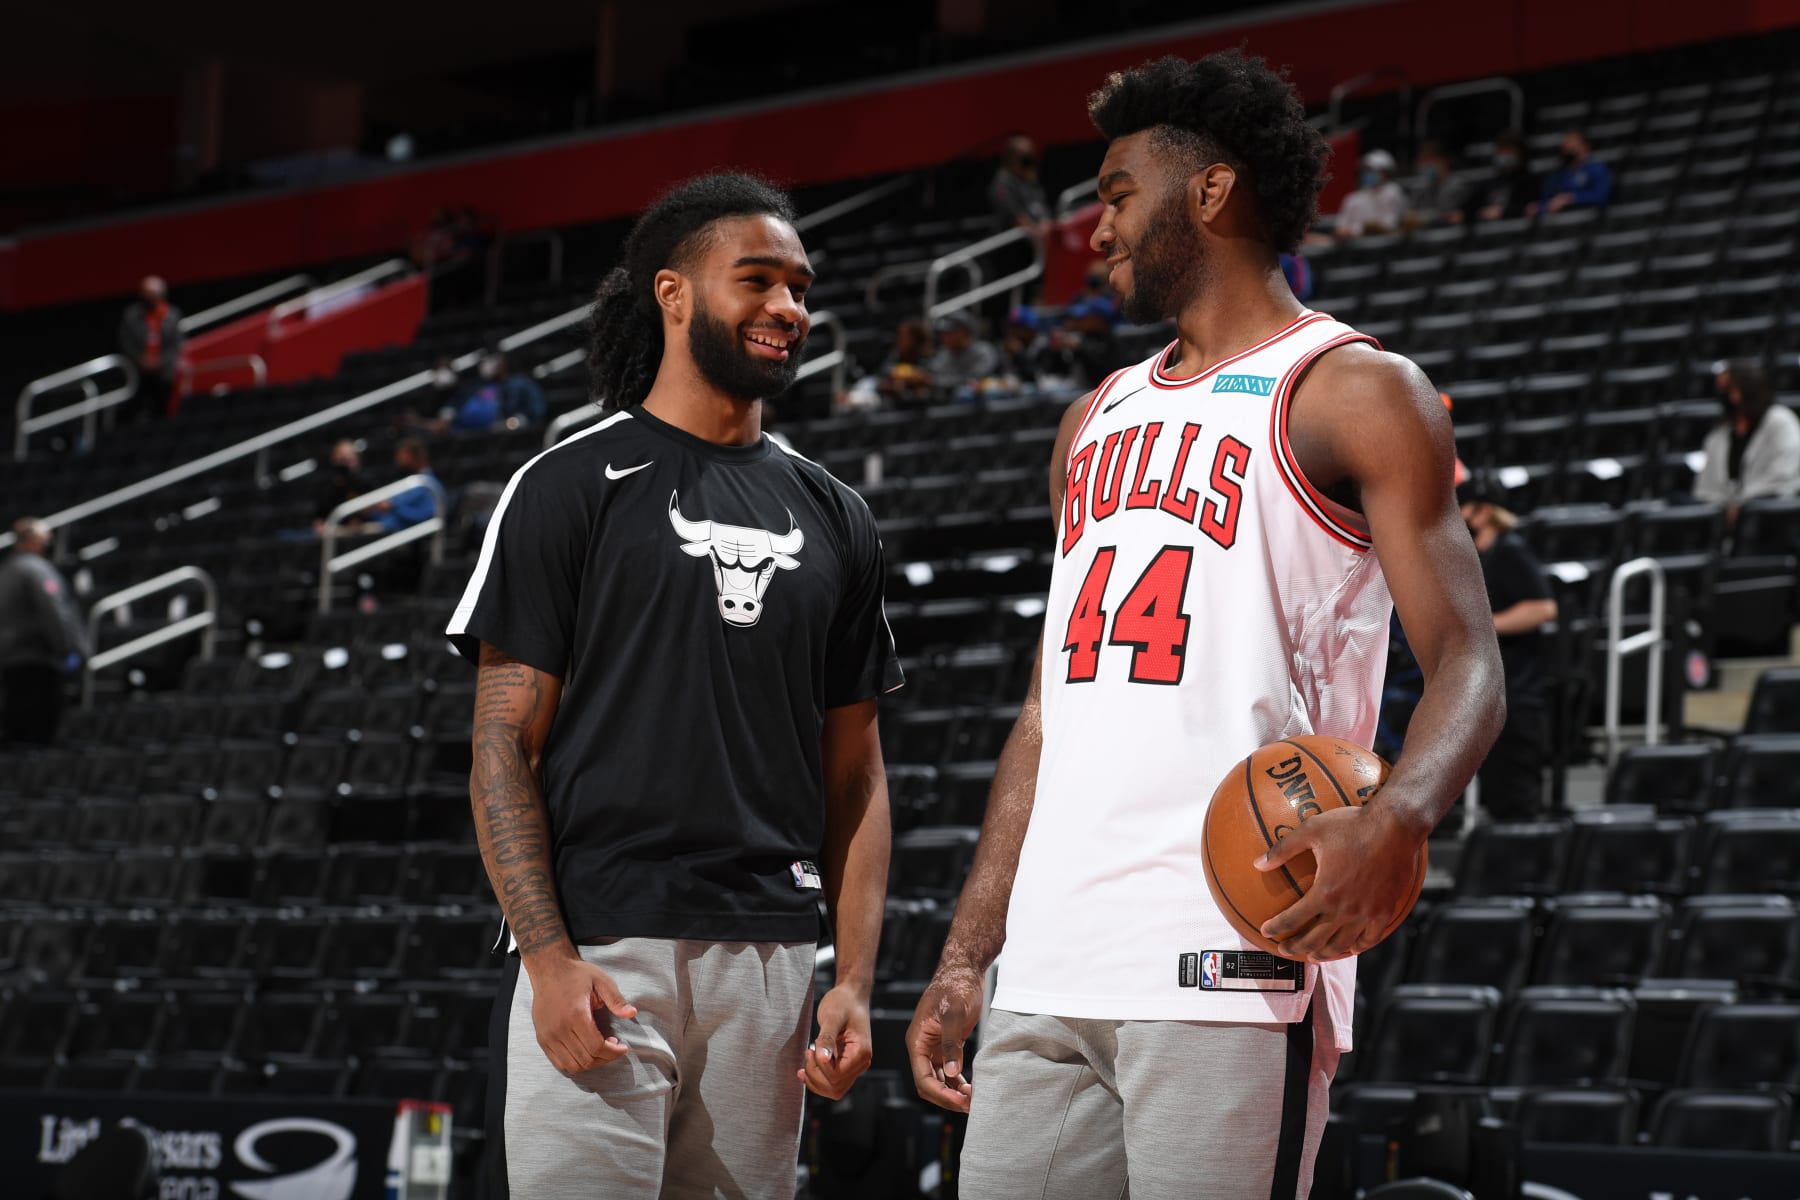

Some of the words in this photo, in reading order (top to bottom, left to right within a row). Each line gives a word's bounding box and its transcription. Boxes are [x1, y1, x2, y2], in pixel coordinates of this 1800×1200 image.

[1062, 421, 1252, 559] BULLS
[1061, 545, 1194, 685] 44
[1265, 754, 1324, 823] DING
[160, 1176, 220, 1200] ena
